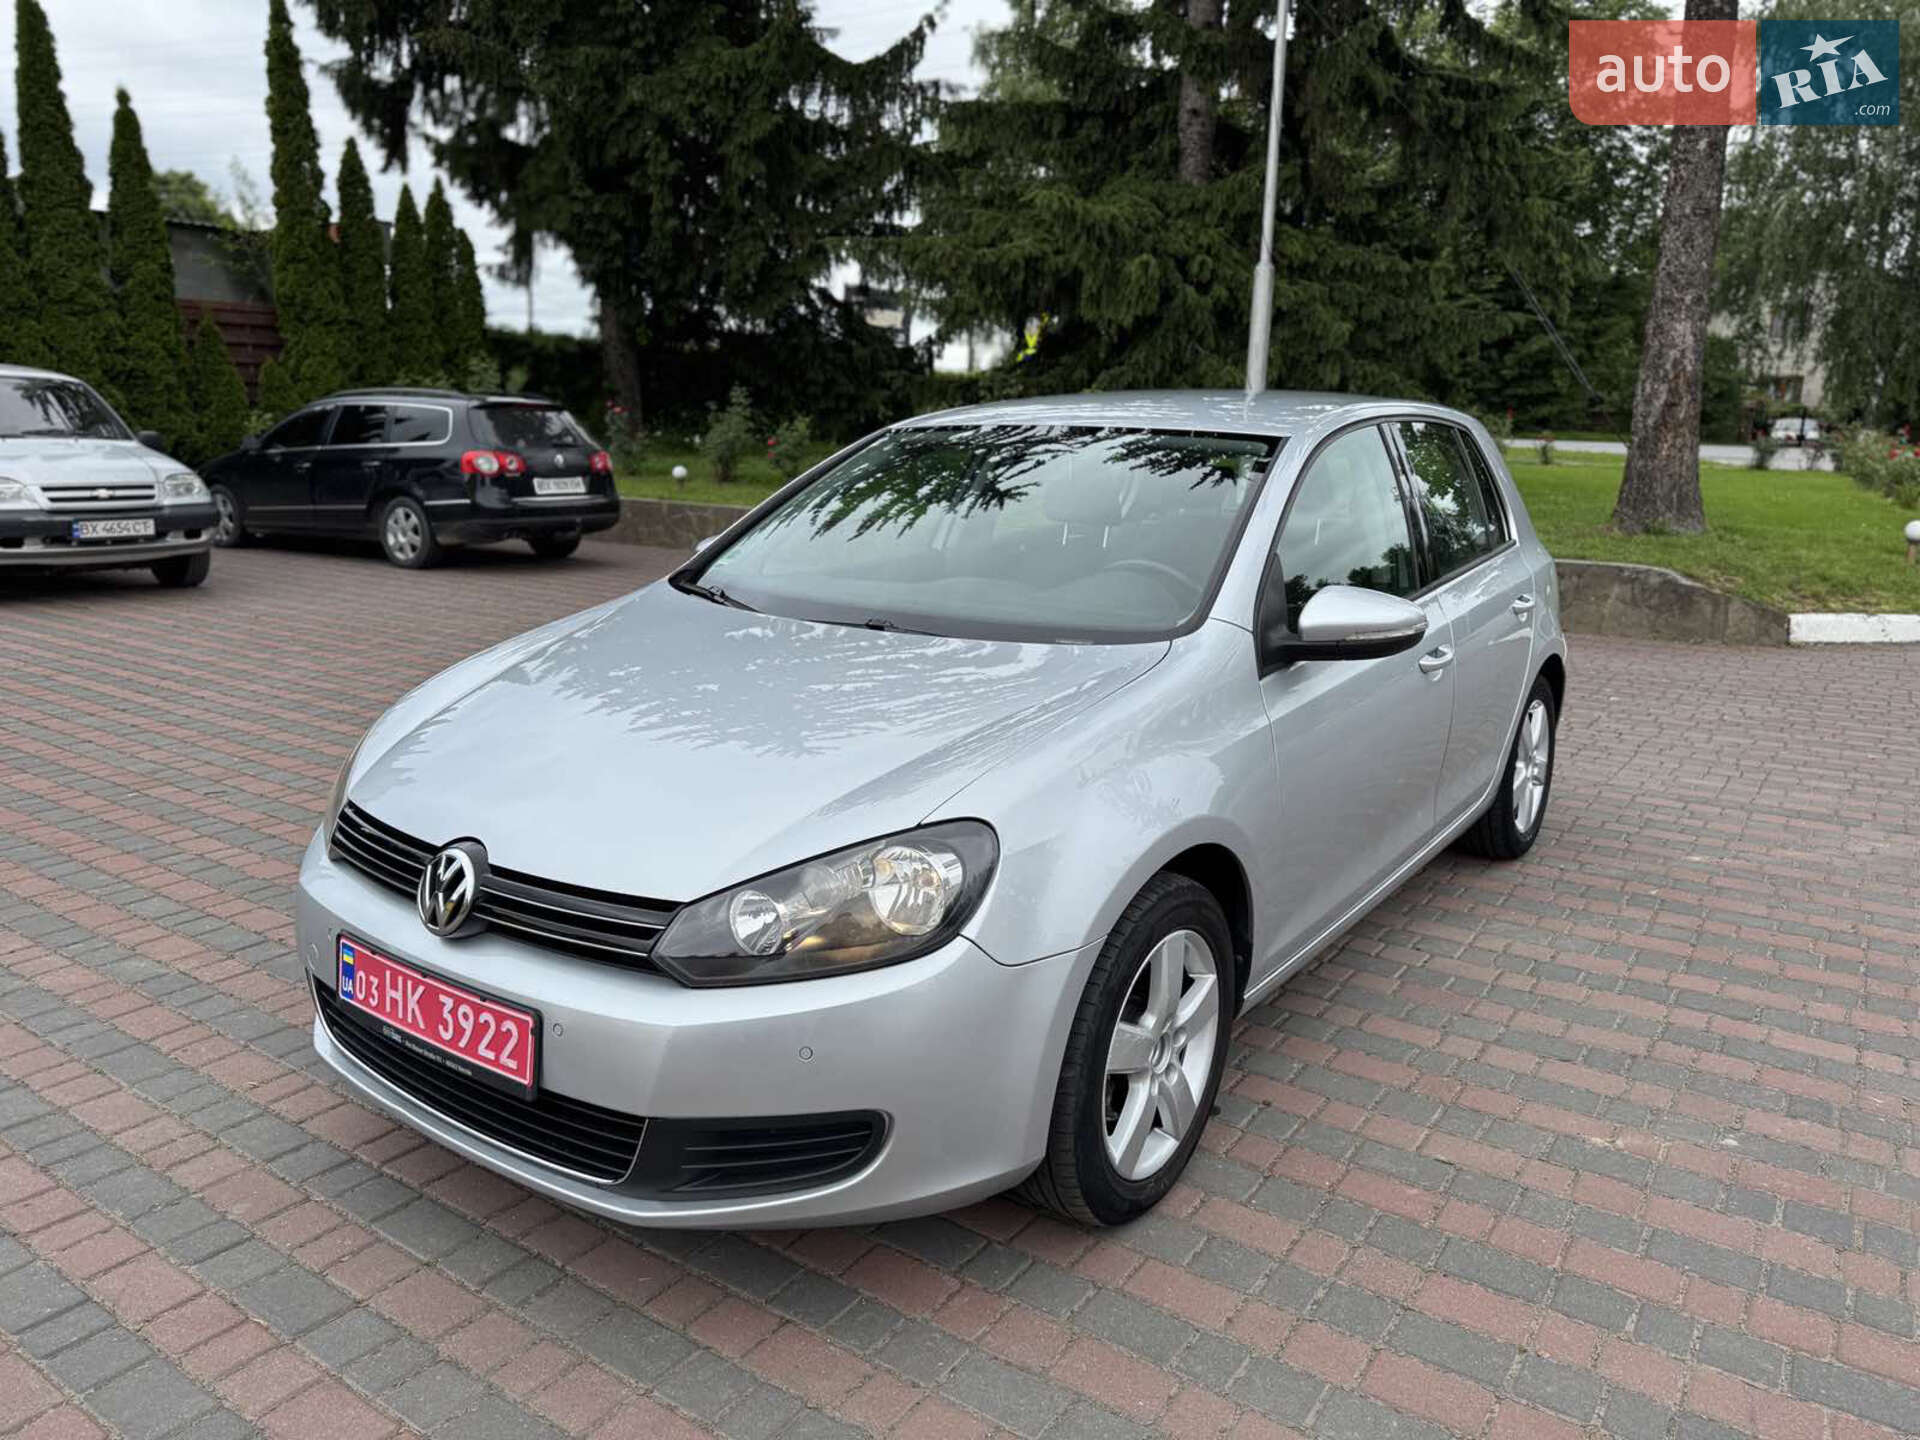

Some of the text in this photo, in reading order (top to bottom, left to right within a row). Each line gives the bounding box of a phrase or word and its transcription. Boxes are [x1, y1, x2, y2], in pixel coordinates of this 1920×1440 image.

[79, 521, 99, 537] BX
[342, 975, 354, 995] UA
[356, 970, 379, 1007] 03
[385, 970, 426, 1030] HK
[438, 992, 519, 1071] 3922
